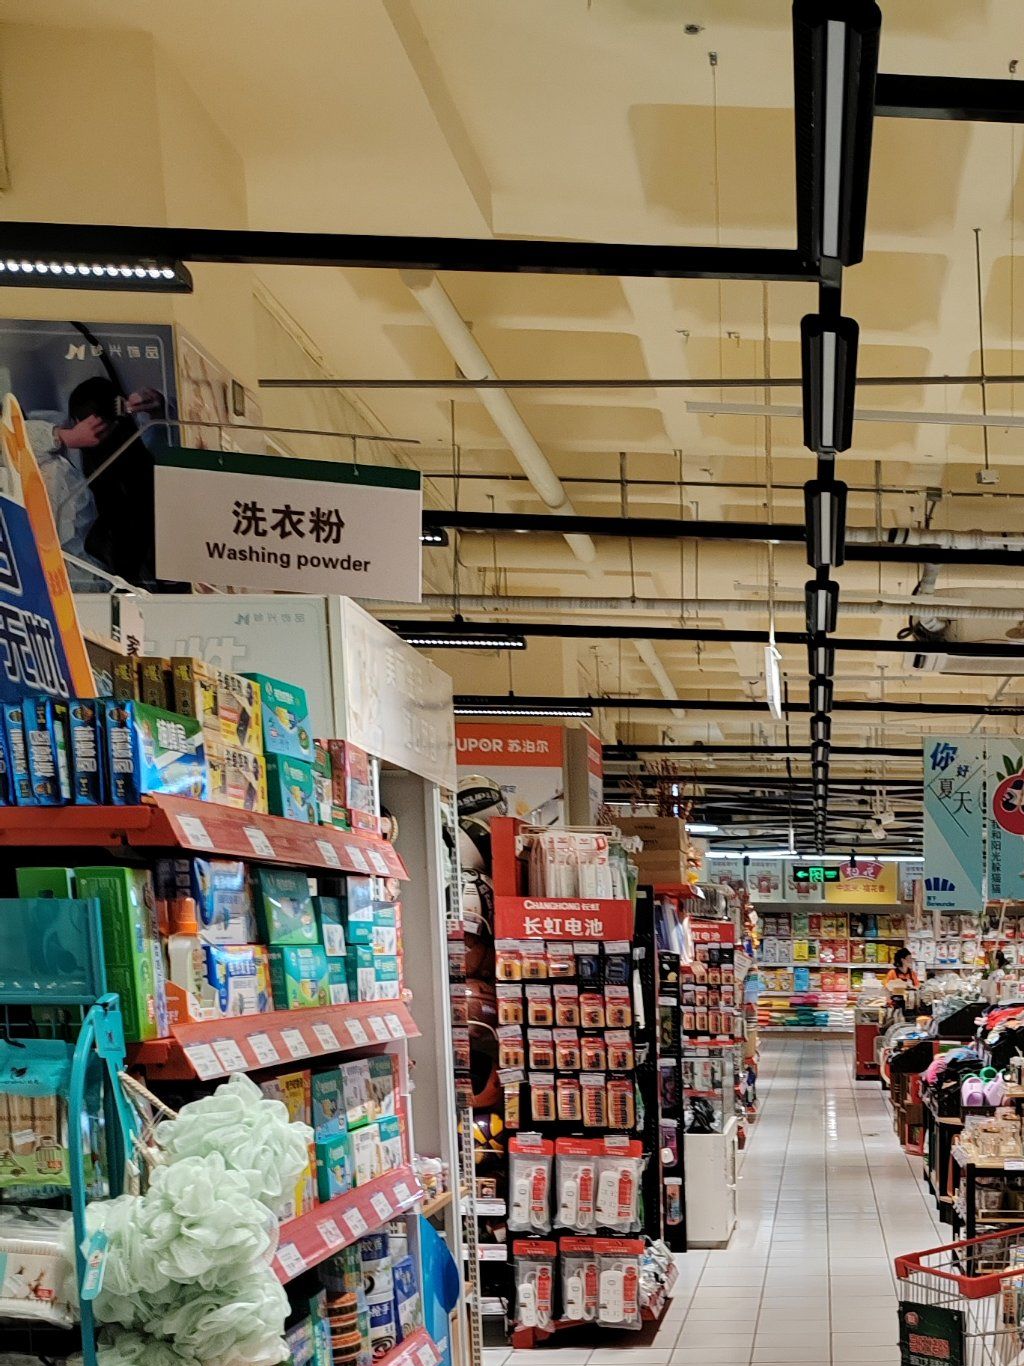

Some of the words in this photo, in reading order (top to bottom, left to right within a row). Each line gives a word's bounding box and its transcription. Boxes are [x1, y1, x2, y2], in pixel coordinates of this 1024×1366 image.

[232, 500, 345, 545] 洗衣粉
[205, 541, 291, 569] Washing
[297, 554, 371, 573] powder
[508, 739, 549, 754] 苏泊尔
[523, 916, 604, 937] 长虹电池
